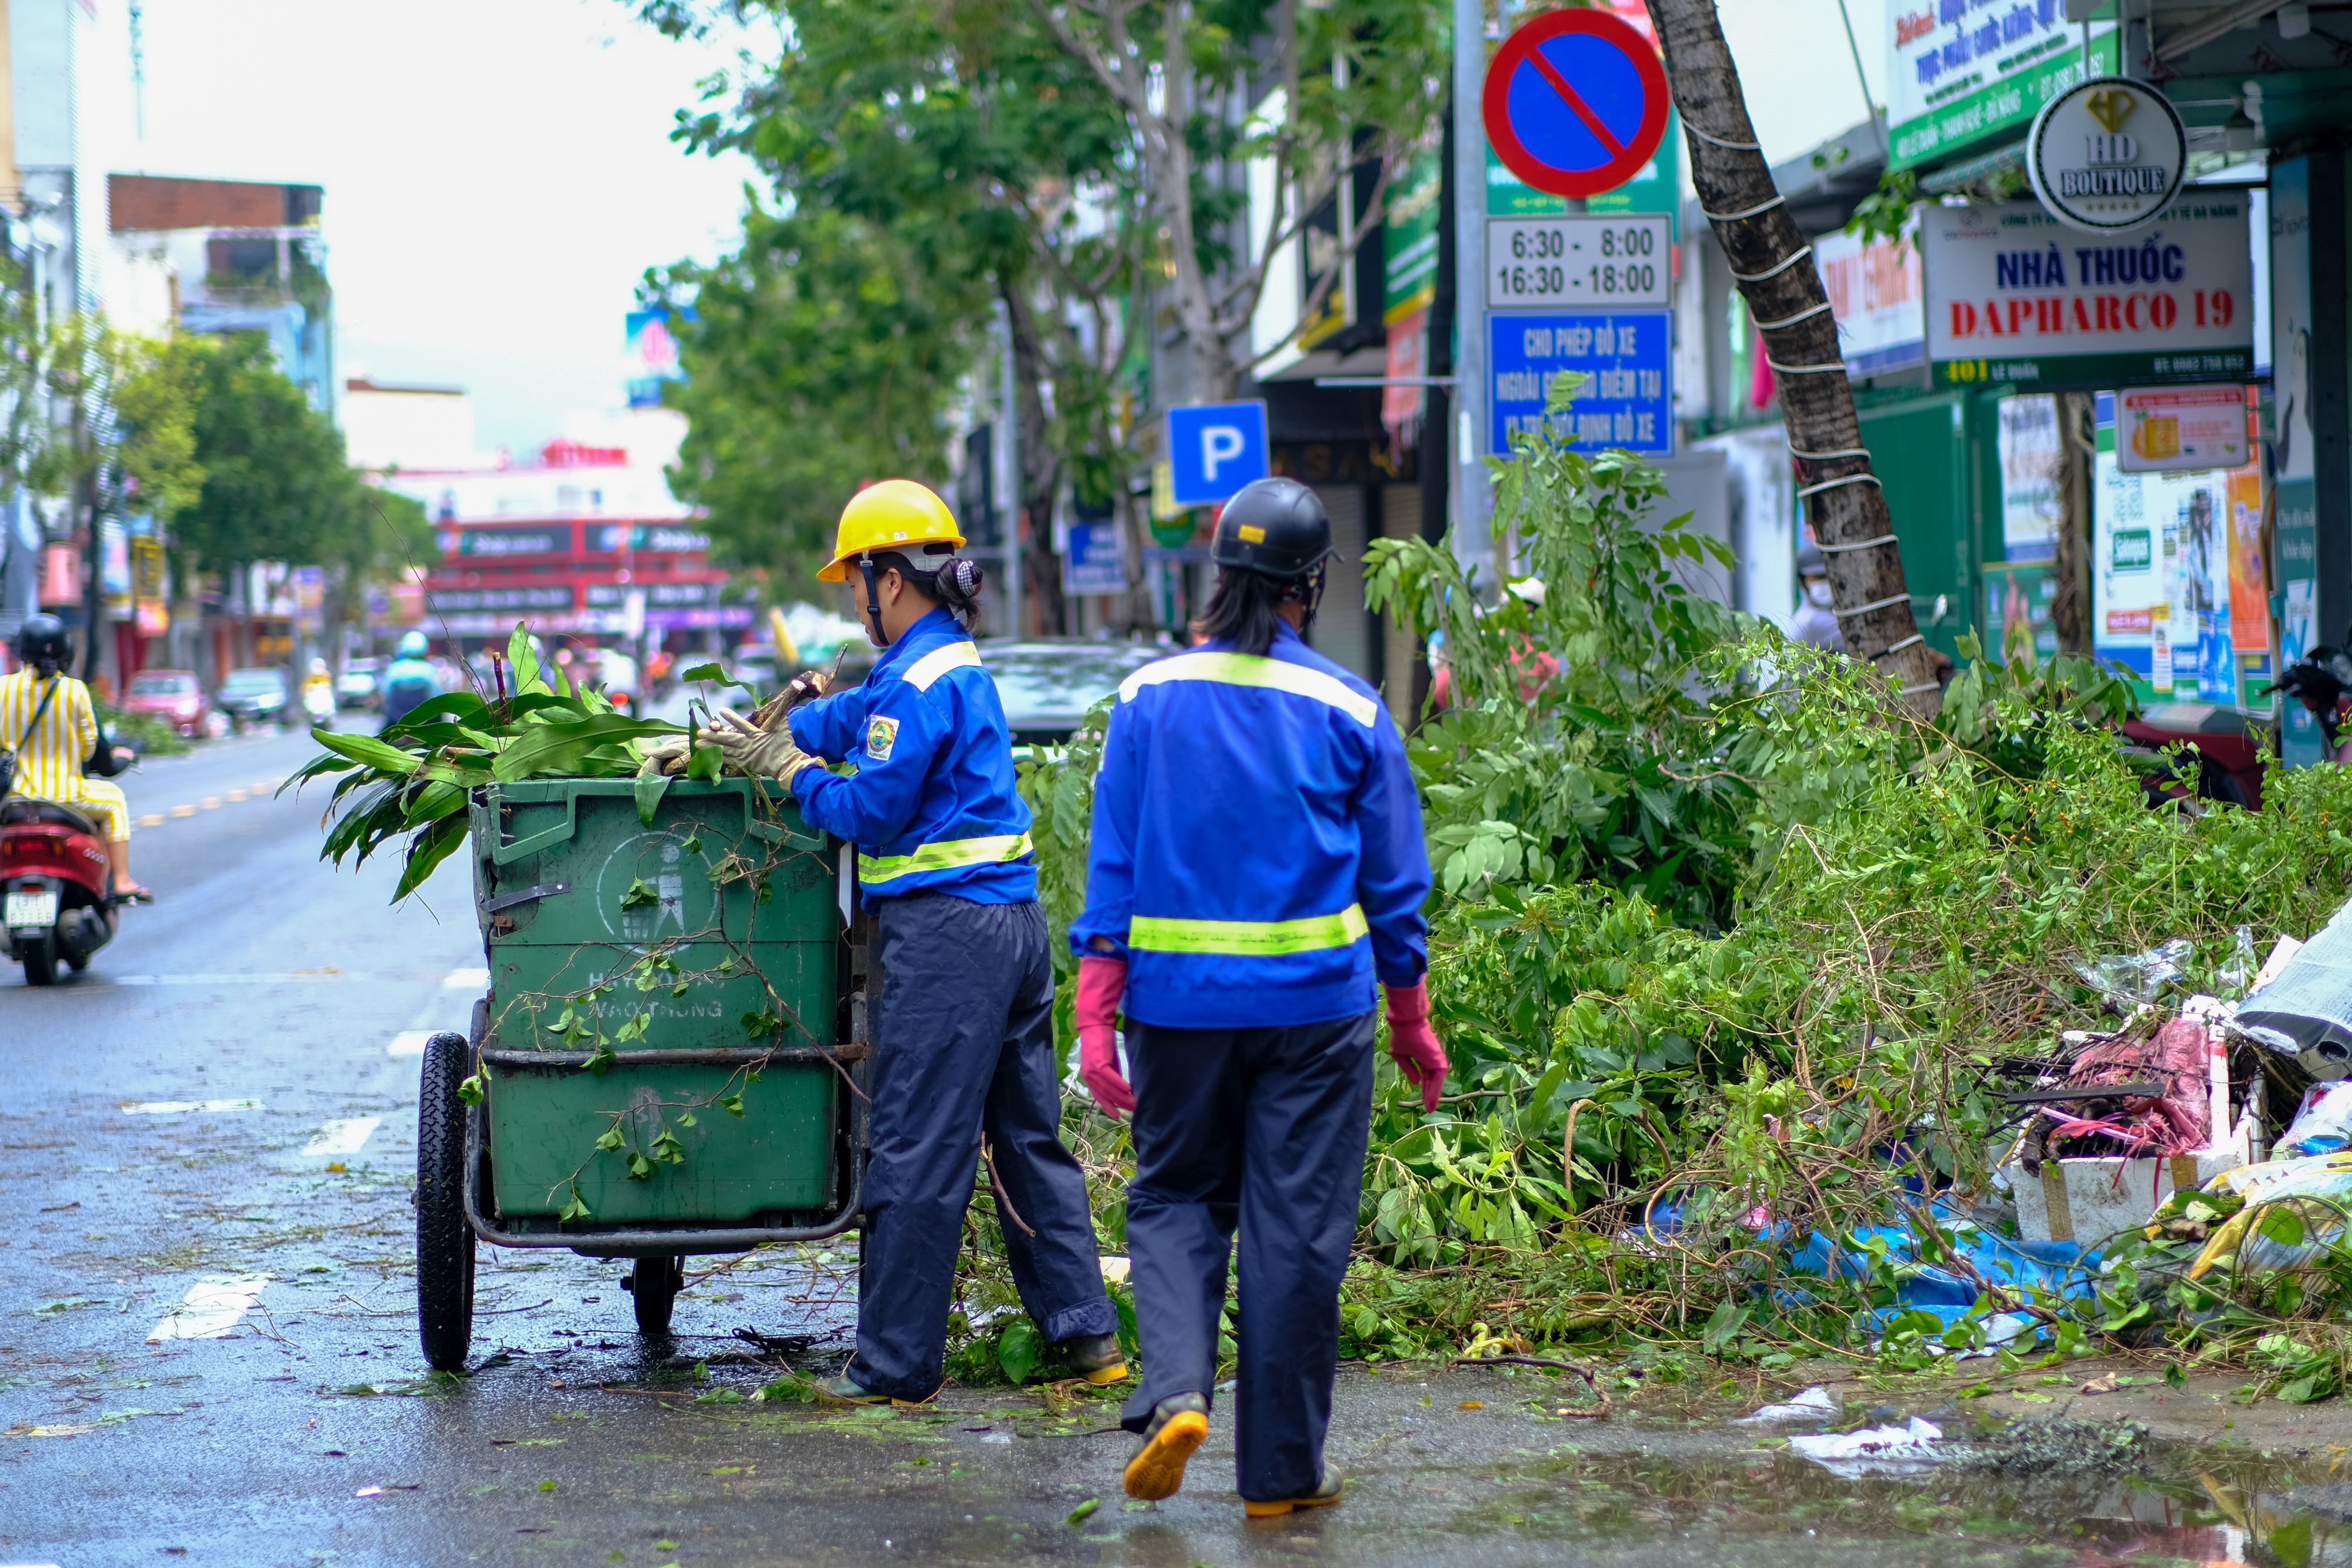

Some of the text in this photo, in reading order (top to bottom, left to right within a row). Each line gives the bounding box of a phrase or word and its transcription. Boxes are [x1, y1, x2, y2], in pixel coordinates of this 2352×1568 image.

[2086, 134, 2138, 165] HD
[2062, 166, 2164, 196] BOUTIQUE
[1512, 230, 1563, 258] 6:30
[1601, 229, 1652, 257] 8:00
[1997, 232, 2186, 288] NHÀ THUỐC
[1498, 266, 1563, 294] 16:30
[1589, 265, 1654, 293] 18:00
[1949, 287, 2234, 339] DAPHARCO 19
[1524, 329, 1552, 356] CHO
[1556, 322, 1593, 356] PHÉP
[1618, 326, 1636, 355] XE
[1601, 358, 1636, 399] ĐIỂM
[1943, 358, 1987, 382] 401
[1637, 412, 1655, 442] XE
[1201, 426, 1244, 482] P
